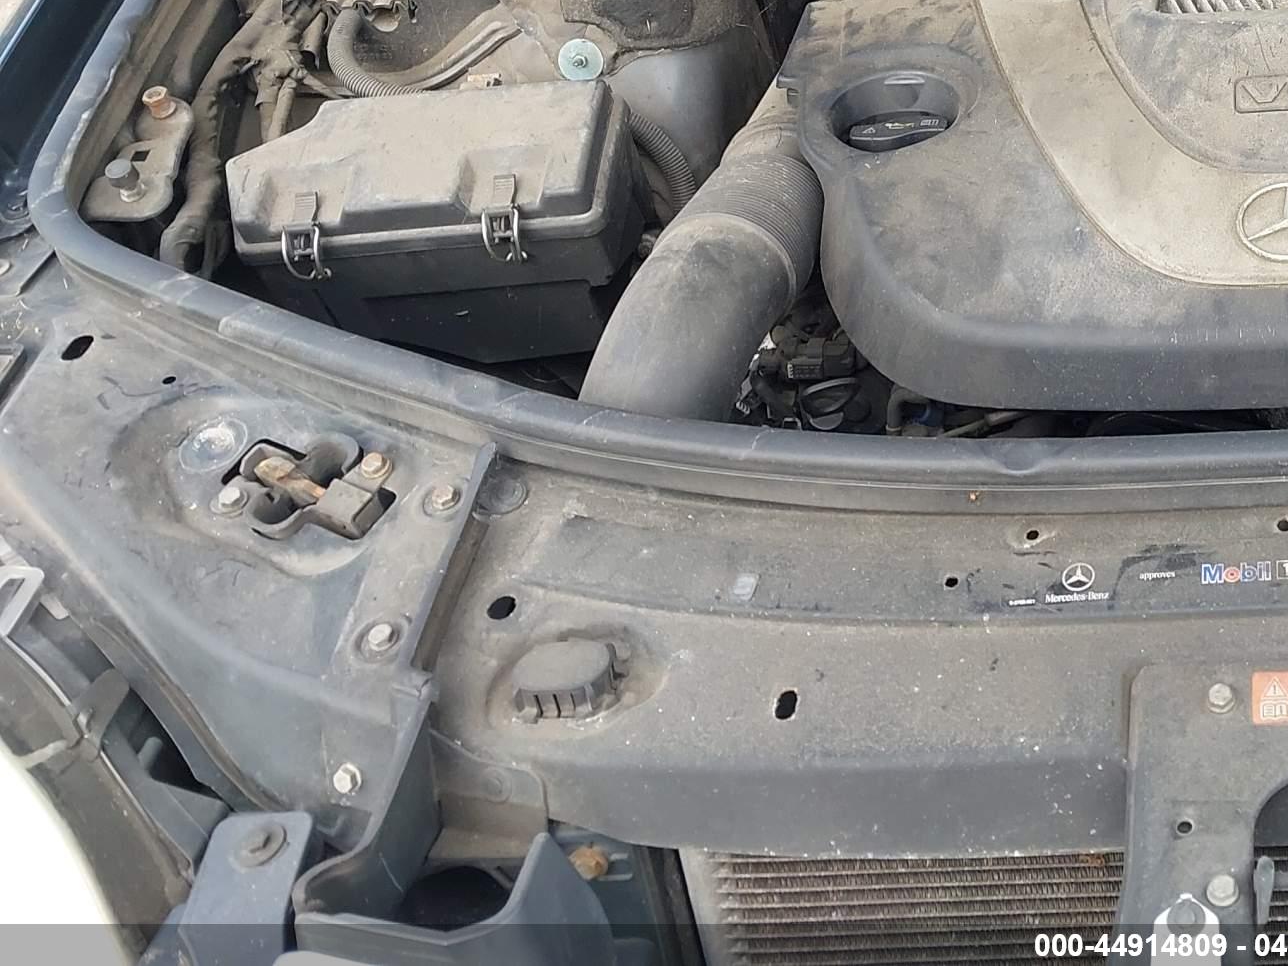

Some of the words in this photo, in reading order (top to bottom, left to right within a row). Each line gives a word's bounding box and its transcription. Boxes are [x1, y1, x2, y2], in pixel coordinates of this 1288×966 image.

[1139, 571, 1176, 581] approves
[1201, 561, 1271, 584] Mobil
[1045, 592, 1110, 604] Mercedes-Benz
